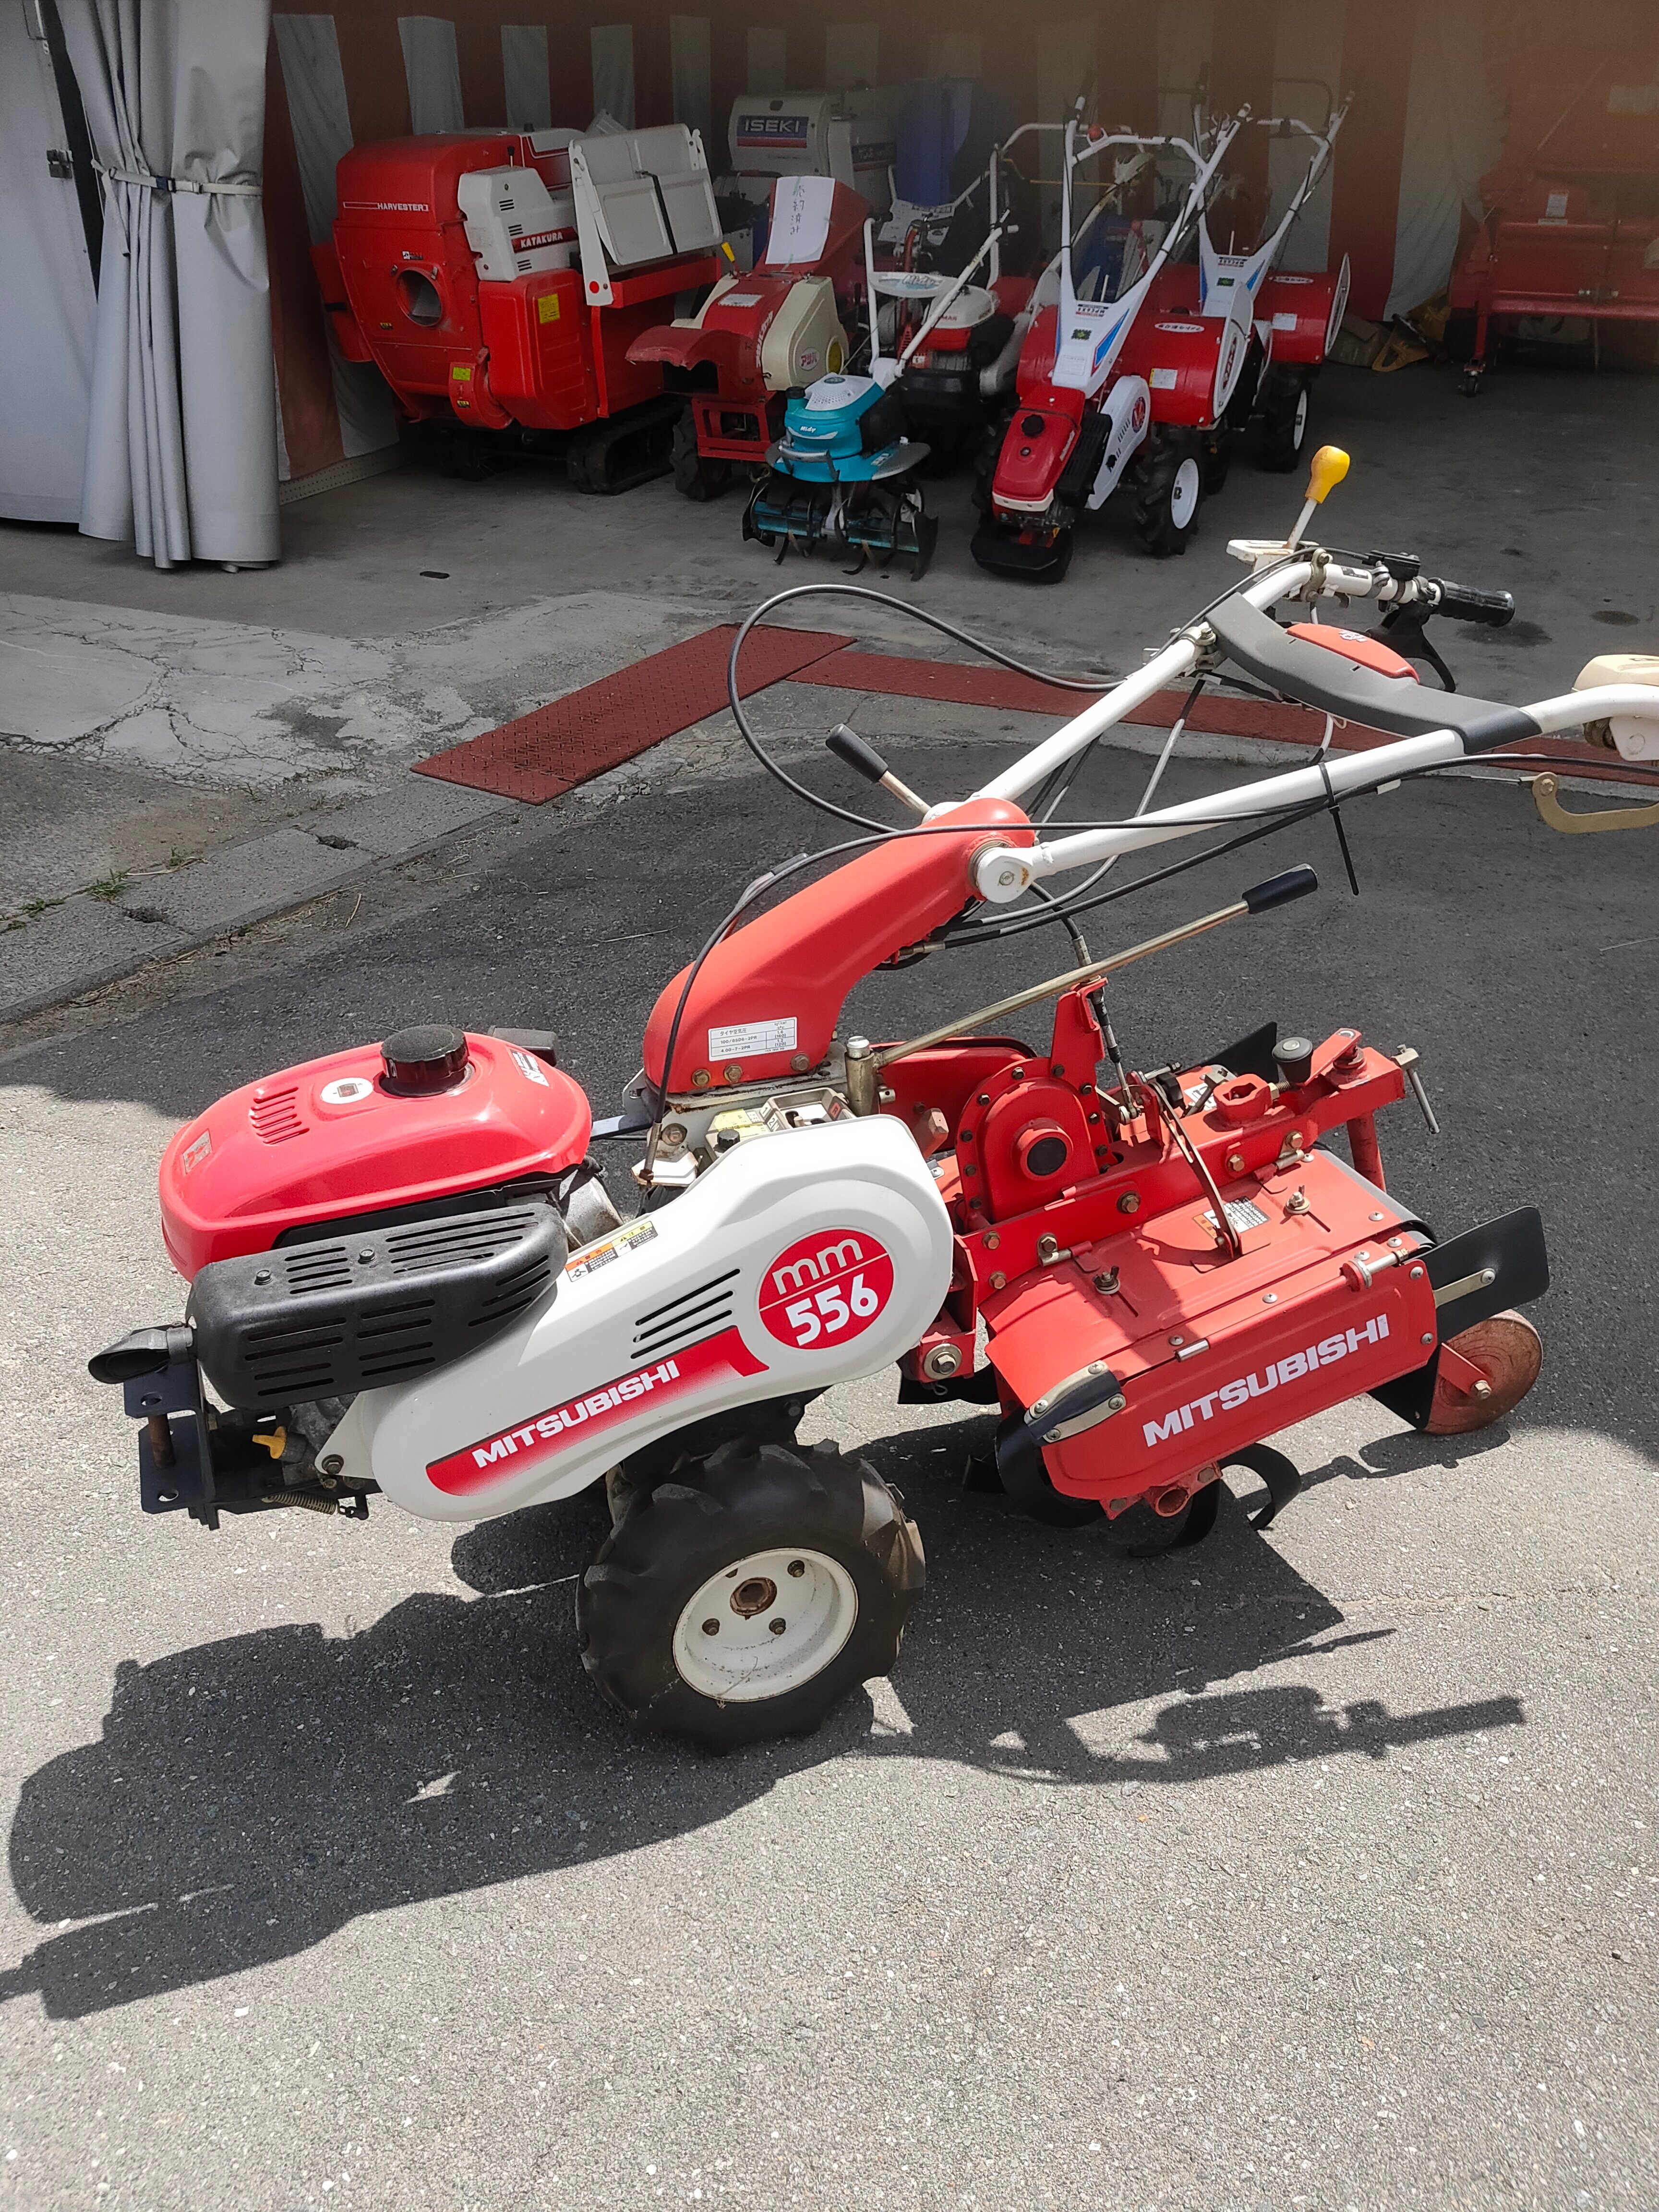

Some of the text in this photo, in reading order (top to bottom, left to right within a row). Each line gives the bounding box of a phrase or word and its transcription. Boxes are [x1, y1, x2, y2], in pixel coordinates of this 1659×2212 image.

[745, 120, 800, 132] ISEKI
[377, 203, 424, 211] HARVESTER
[521, 231, 563, 248] KATAKURA
[720, 1028, 747, 1036] タイヤ空気圧
[721, 1035, 757, 1044] 100/85D6-2PR
[761, 1106, 768, 1118] 1
[832, 1106, 838, 1115] R
[769, 1118, 775, 1127] 2
[771, 1238, 864, 1296] mm
[785, 1273, 878, 1346] 556
[1142, 1313, 1390, 1447] MITSUBISHI
[471, 1360, 681, 1468] MITSUBISHI
